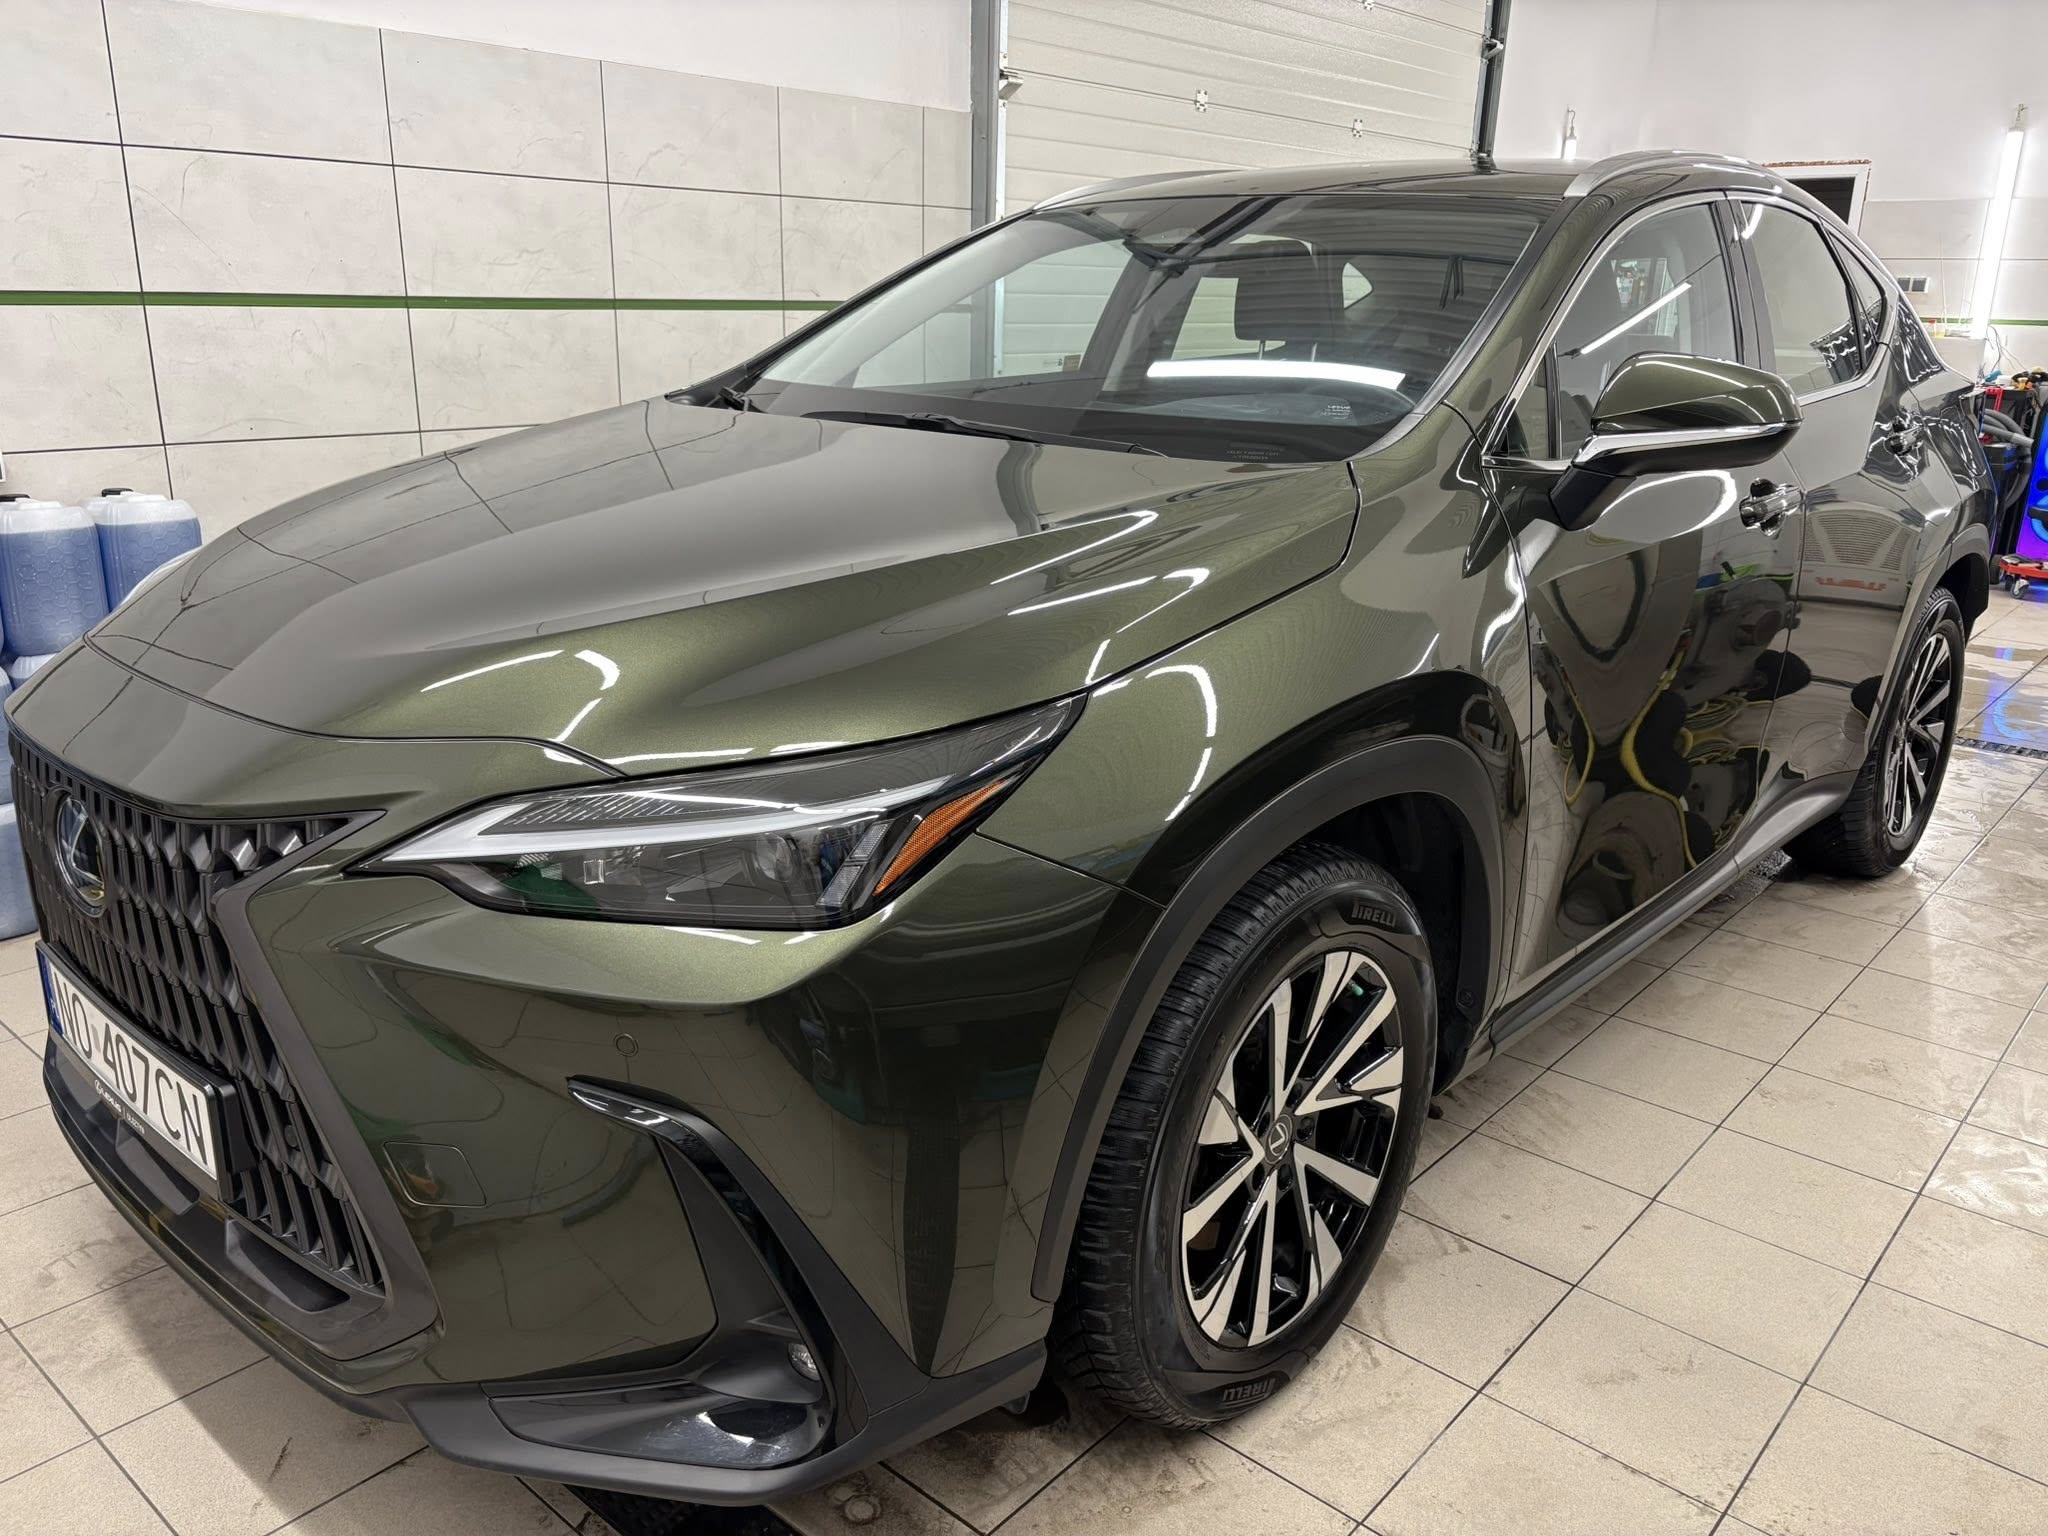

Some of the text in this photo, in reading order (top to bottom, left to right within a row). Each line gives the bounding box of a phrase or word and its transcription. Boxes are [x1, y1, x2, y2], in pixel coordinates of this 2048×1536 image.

[1351, 899, 1397, 927] PIRELLI
[54, 972, 208, 1166] NO 407CN
[1222, 1377, 1277, 1406] PIRELLI
